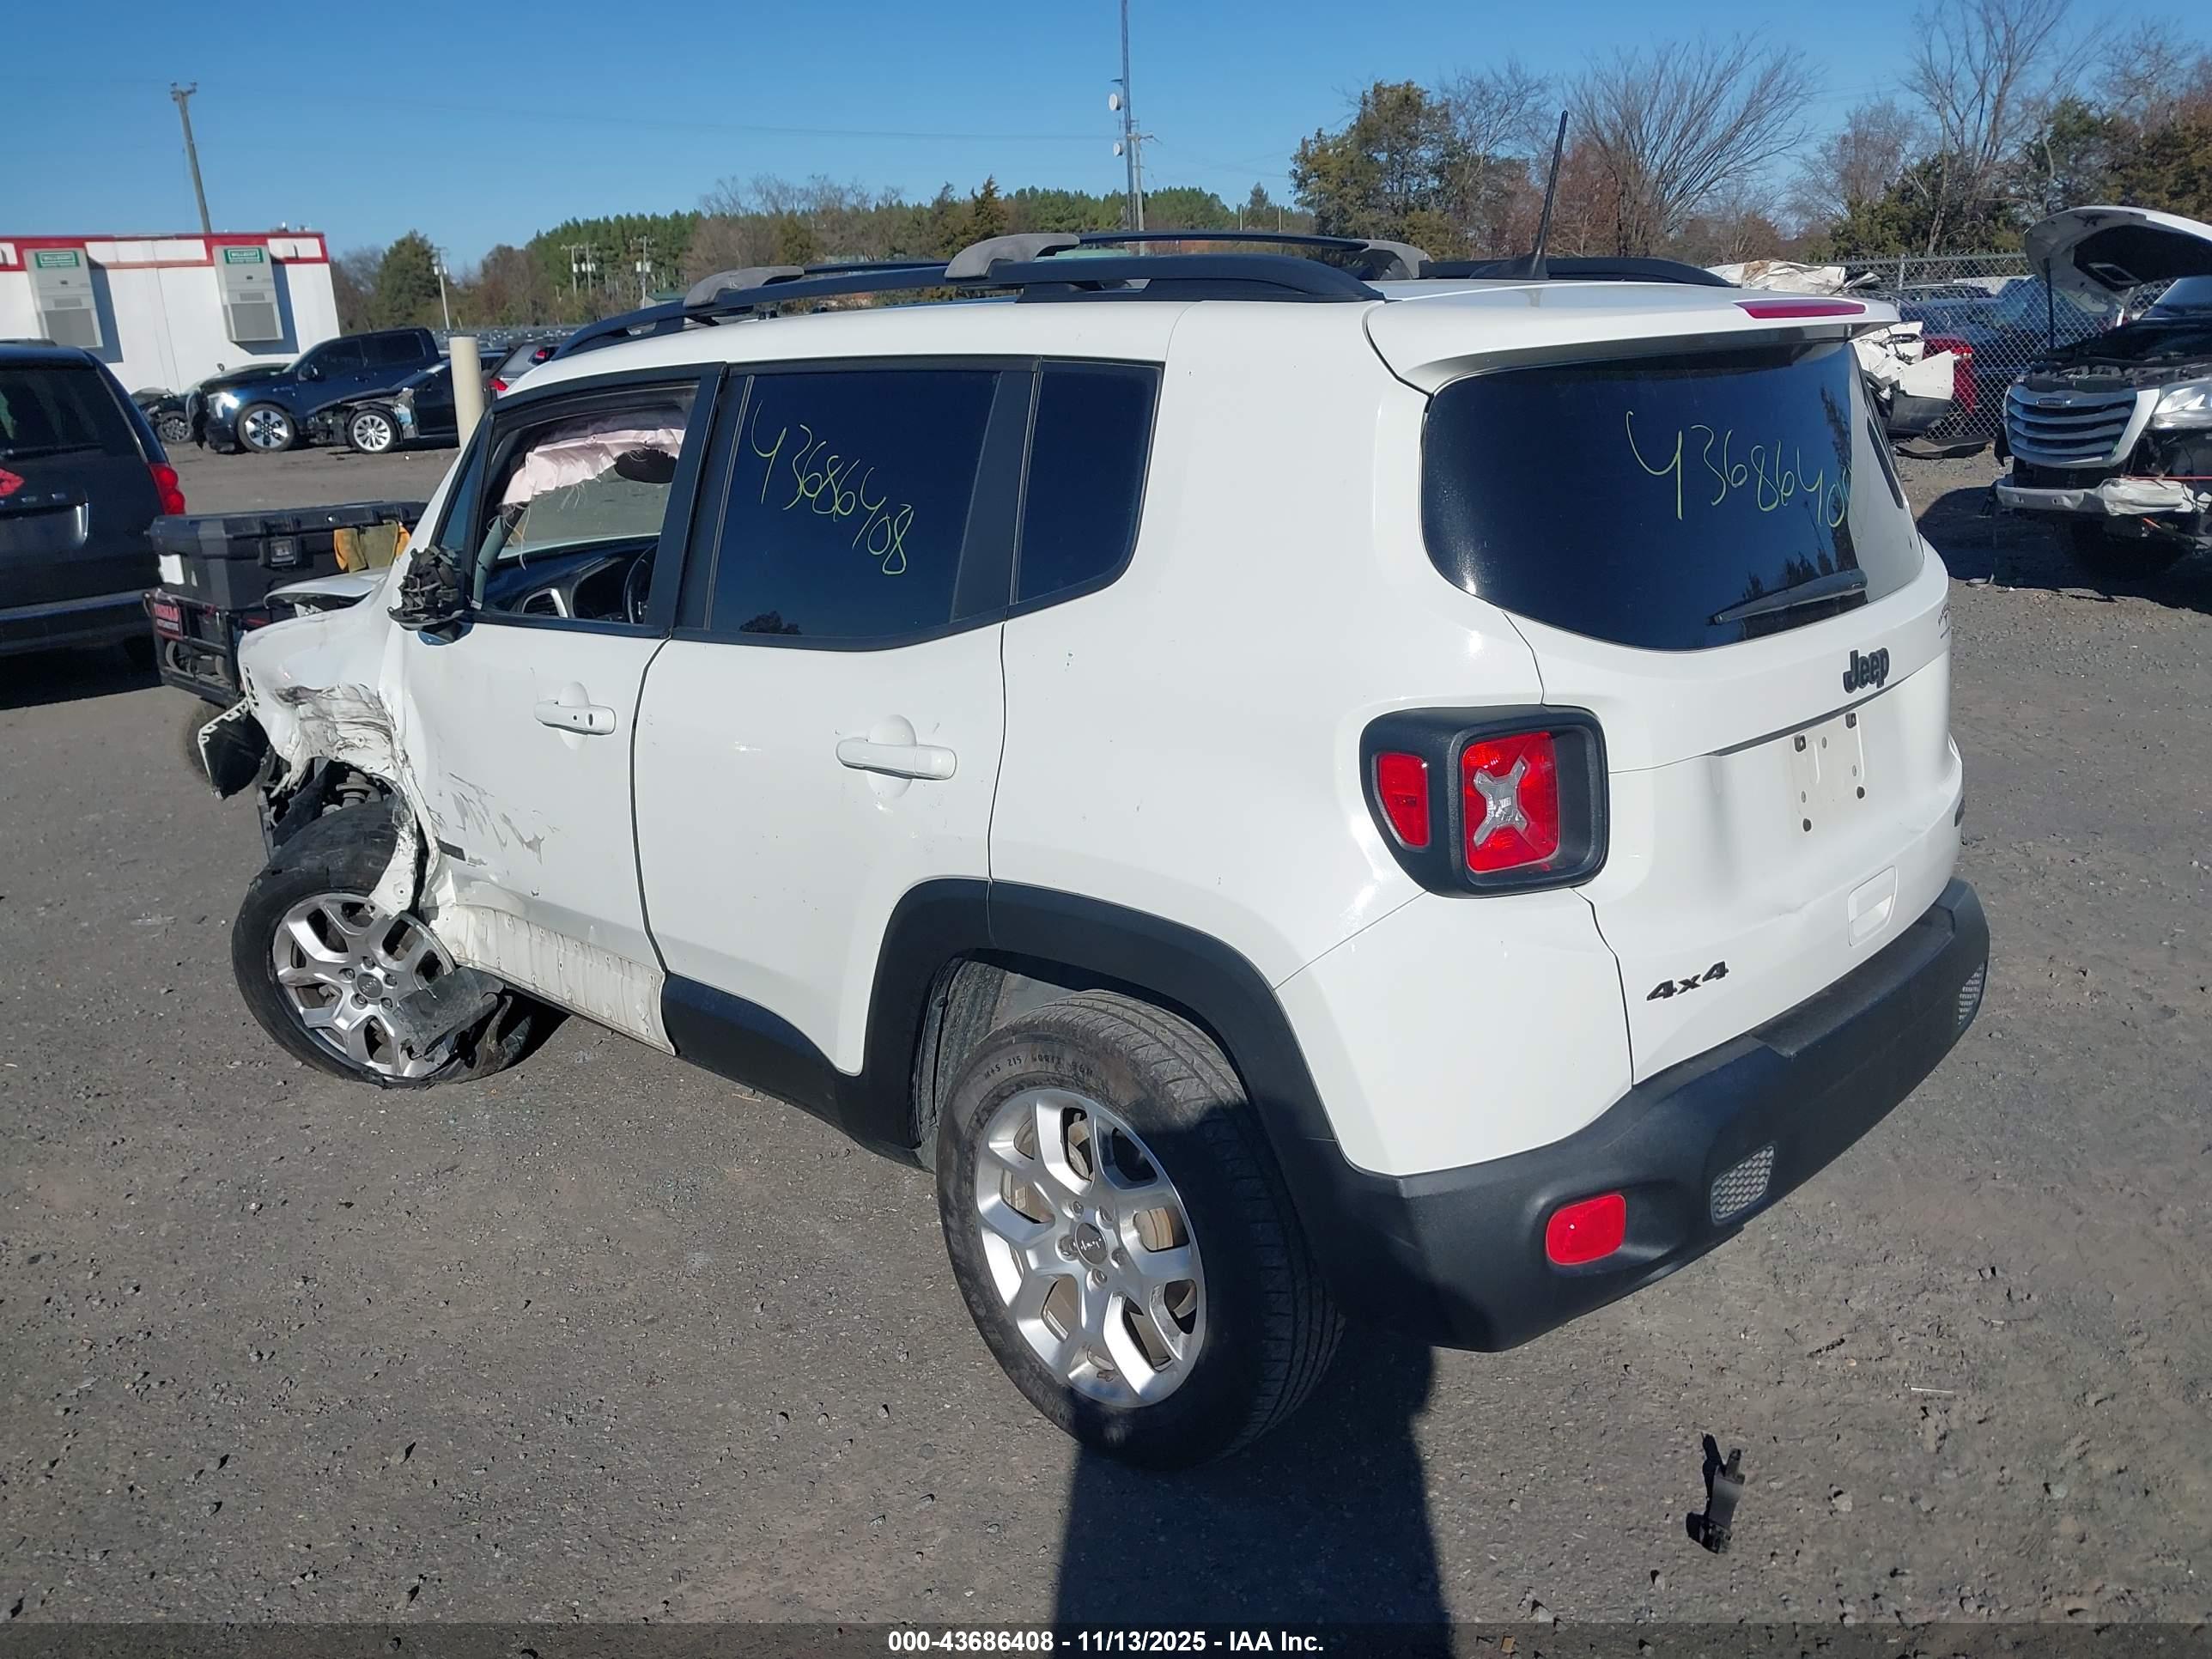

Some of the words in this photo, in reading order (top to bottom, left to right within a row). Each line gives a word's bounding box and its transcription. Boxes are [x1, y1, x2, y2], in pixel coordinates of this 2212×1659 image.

[750, 399, 915, 575] 43686408
[1842, 647, 1890, 694] Jeep
[1645, 960, 1729, 1001] 4x4
